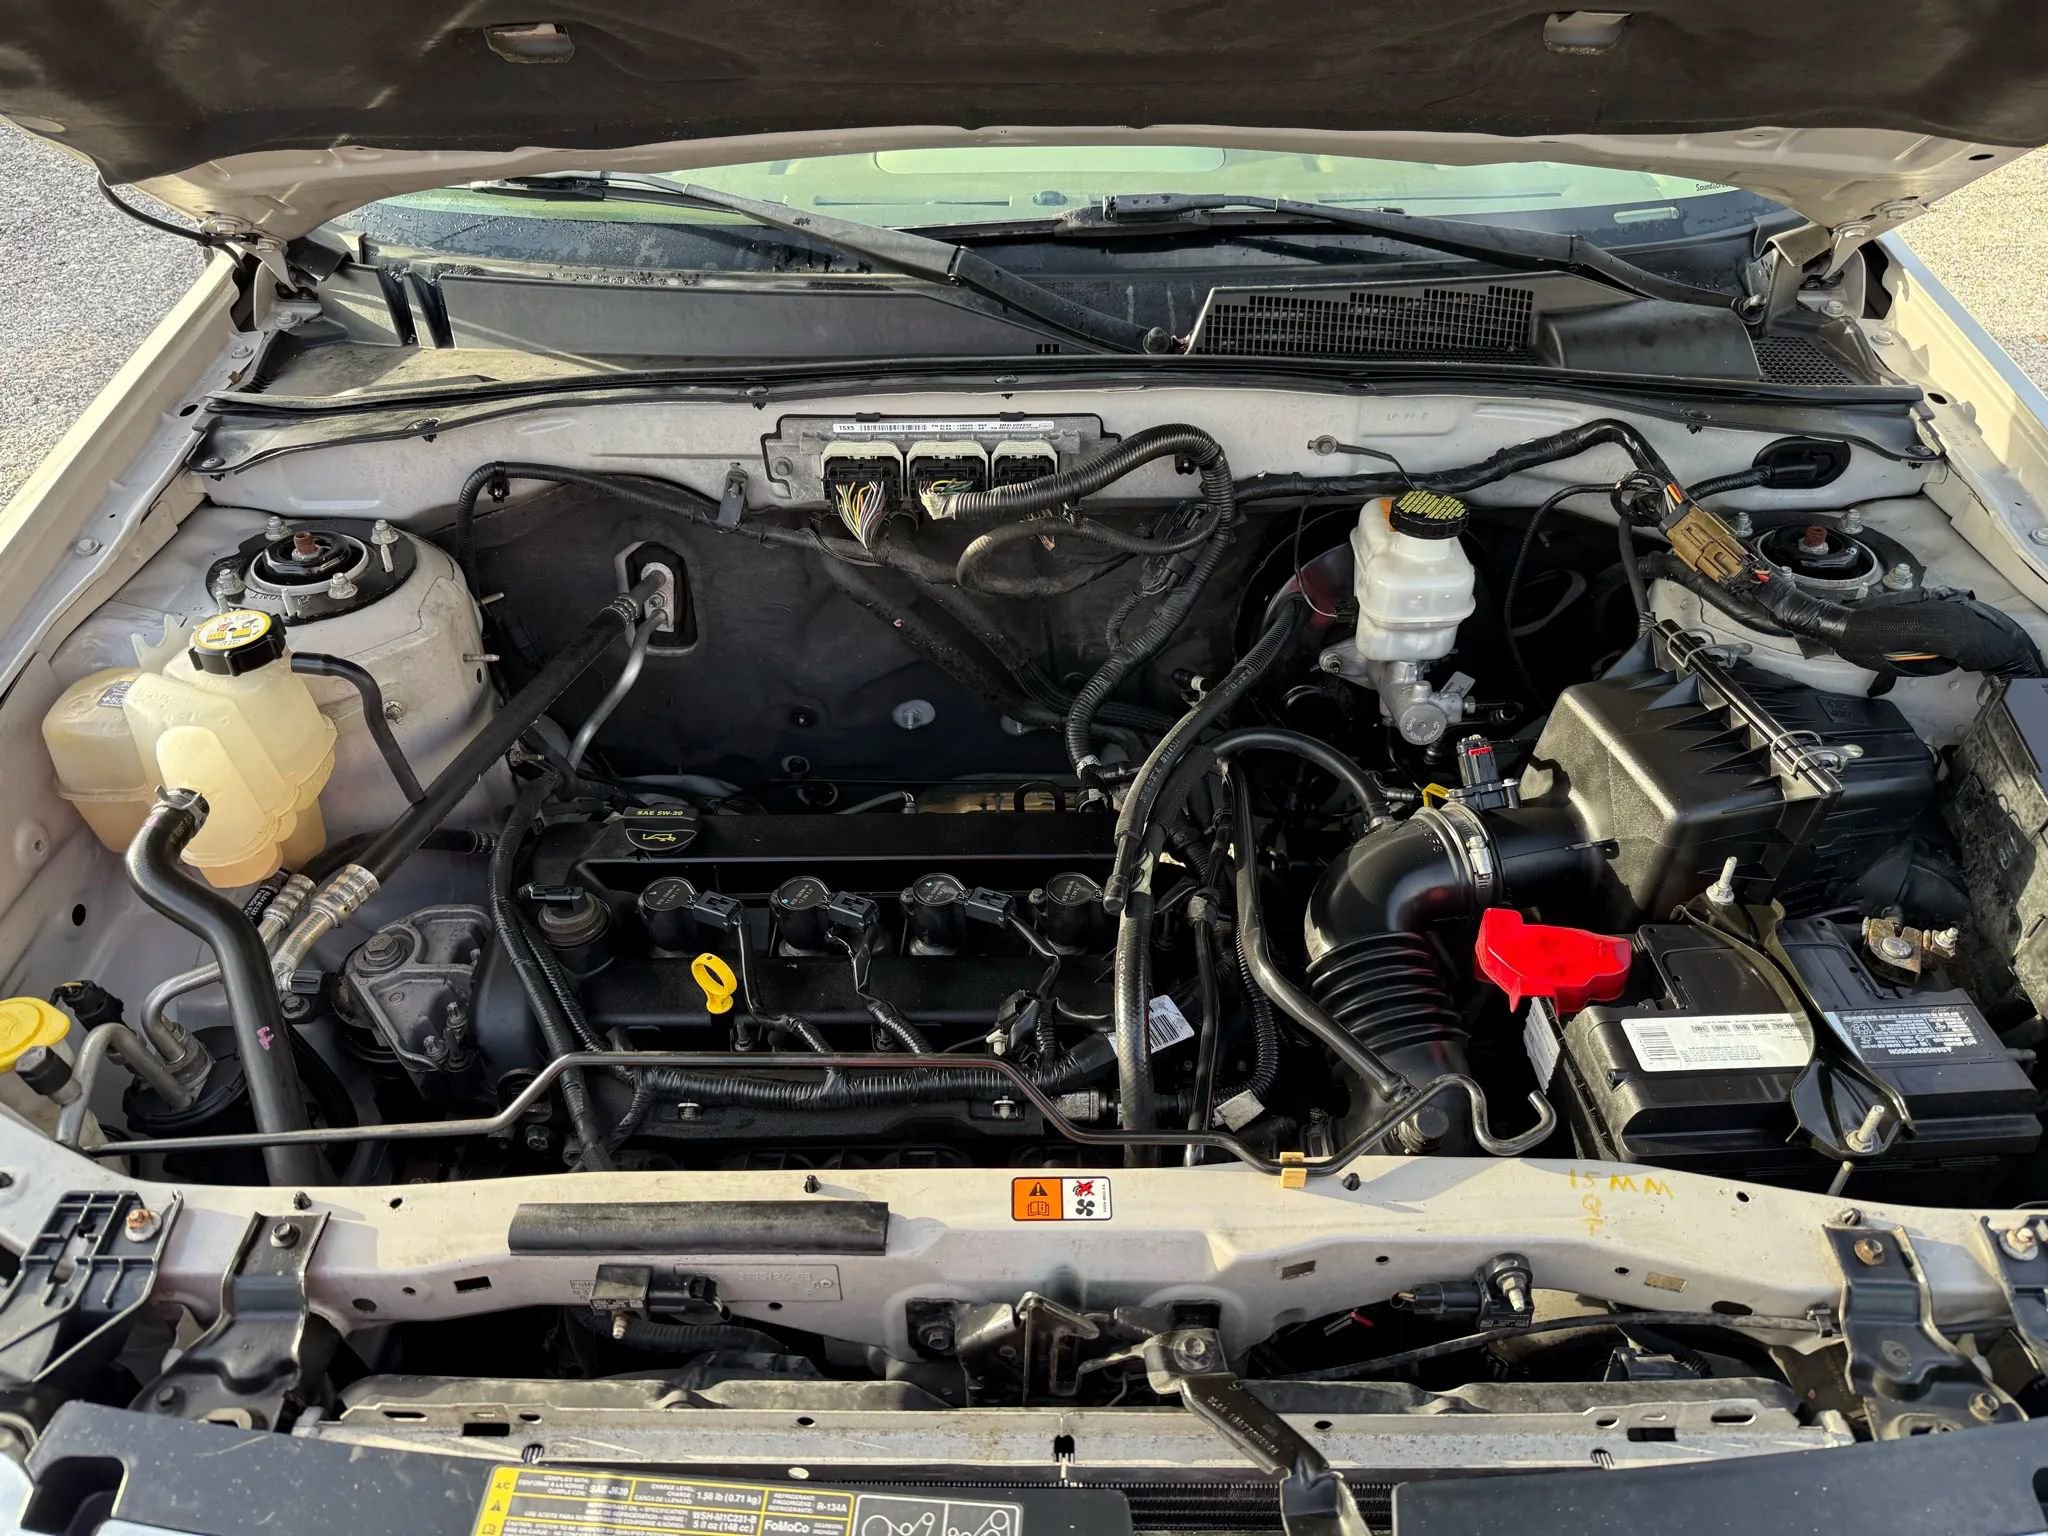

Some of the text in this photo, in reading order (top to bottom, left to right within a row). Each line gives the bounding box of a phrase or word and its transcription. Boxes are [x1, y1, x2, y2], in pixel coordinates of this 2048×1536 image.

[589, 1484, 629, 1496] SAE J639
[651, 1483, 675, 1491] CHARGE
[714, 1492, 724, 1502] lb
[746, 1494, 762, 1506] kg)
[816, 1501, 848, 1512] R-134A
[764, 1519, 810, 1533] FoMoCo
